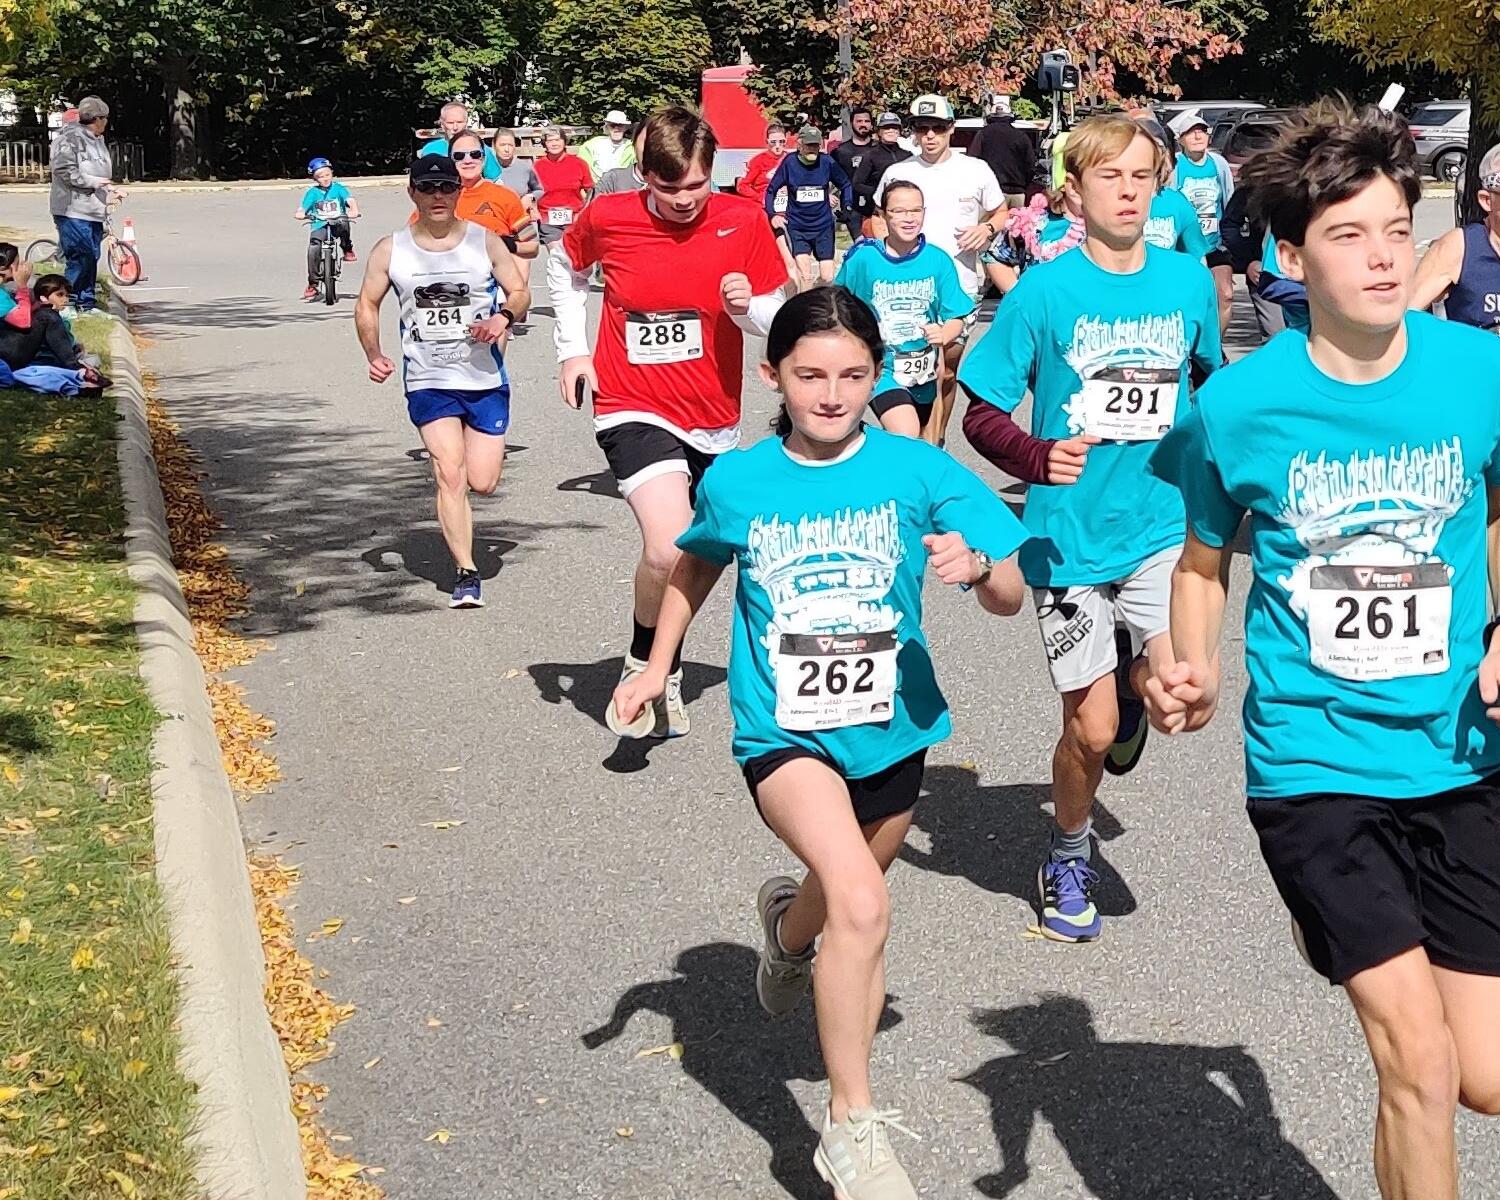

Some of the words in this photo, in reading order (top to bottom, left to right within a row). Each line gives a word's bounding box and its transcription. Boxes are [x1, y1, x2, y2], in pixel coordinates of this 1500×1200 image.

[425, 308, 462, 326] 264
[638, 323, 687, 345] 288
[1105, 386, 1160, 414] 291
[1045, 609, 1088, 647] NDER
[1335, 594, 1421, 639] 261
[797, 658, 875, 696] 262
